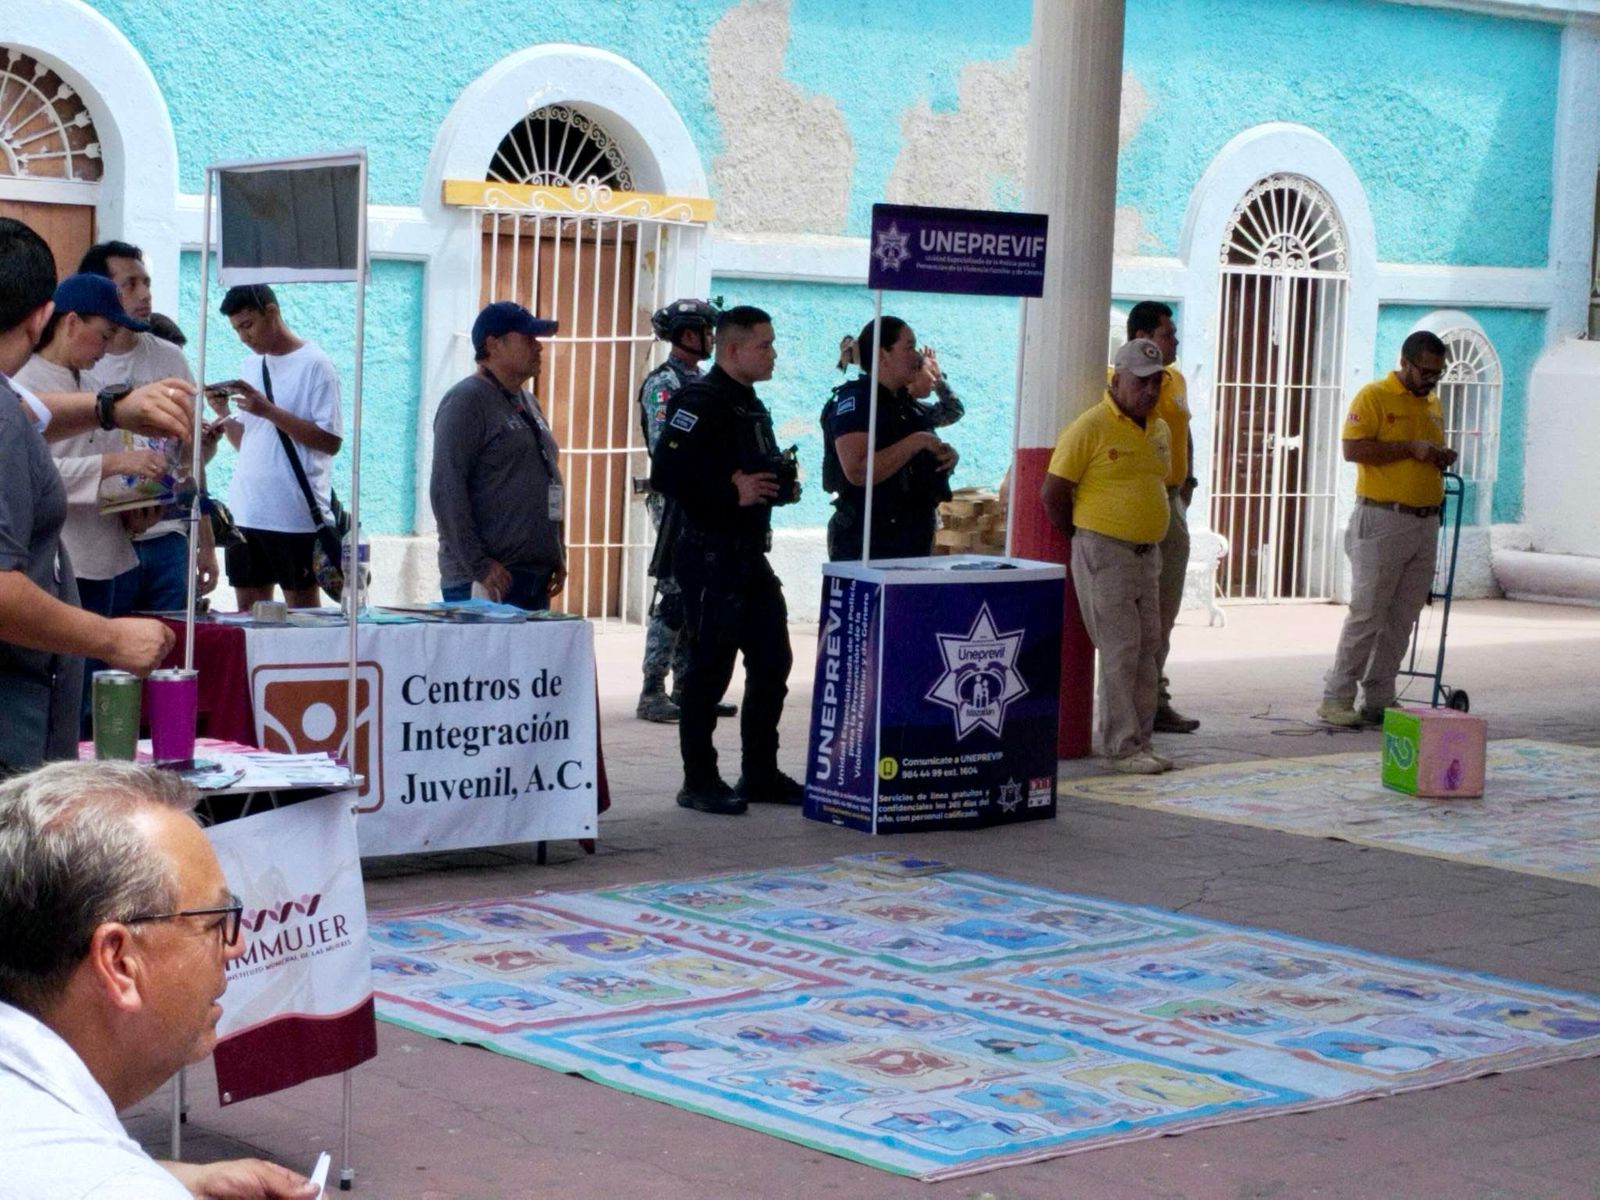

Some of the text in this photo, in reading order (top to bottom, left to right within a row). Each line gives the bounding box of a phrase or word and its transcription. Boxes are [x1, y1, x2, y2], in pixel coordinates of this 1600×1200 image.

[919, 228, 1045, 257] UNEPREVIF
[401, 669, 563, 706] Centros de
[816, 577, 844, 781] UNEPREVIF
[400, 712, 571, 756] Integración
[400, 760, 593, 805] Juvenil, A.C.
